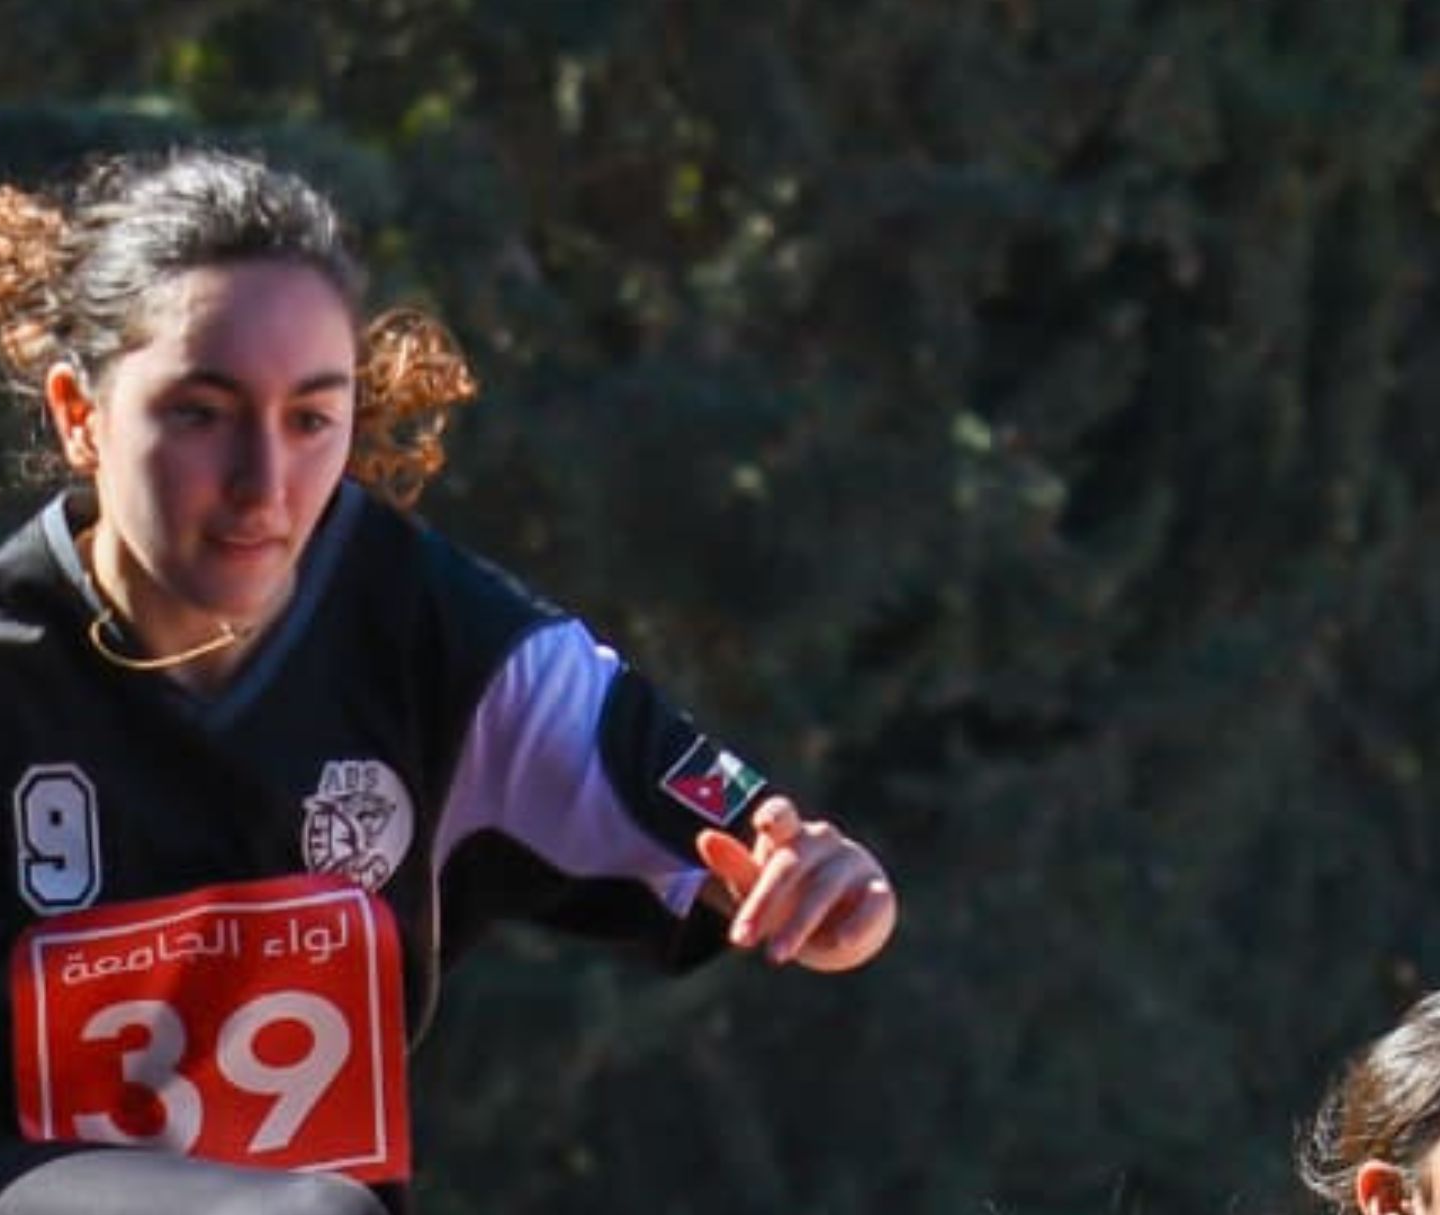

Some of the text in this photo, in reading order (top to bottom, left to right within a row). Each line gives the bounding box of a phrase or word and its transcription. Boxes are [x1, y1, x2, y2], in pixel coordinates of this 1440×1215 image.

[16, 764, 101, 914] 9
[62, 910, 349, 986] لواء الجامعة
[71, 989, 352, 1157] 39
